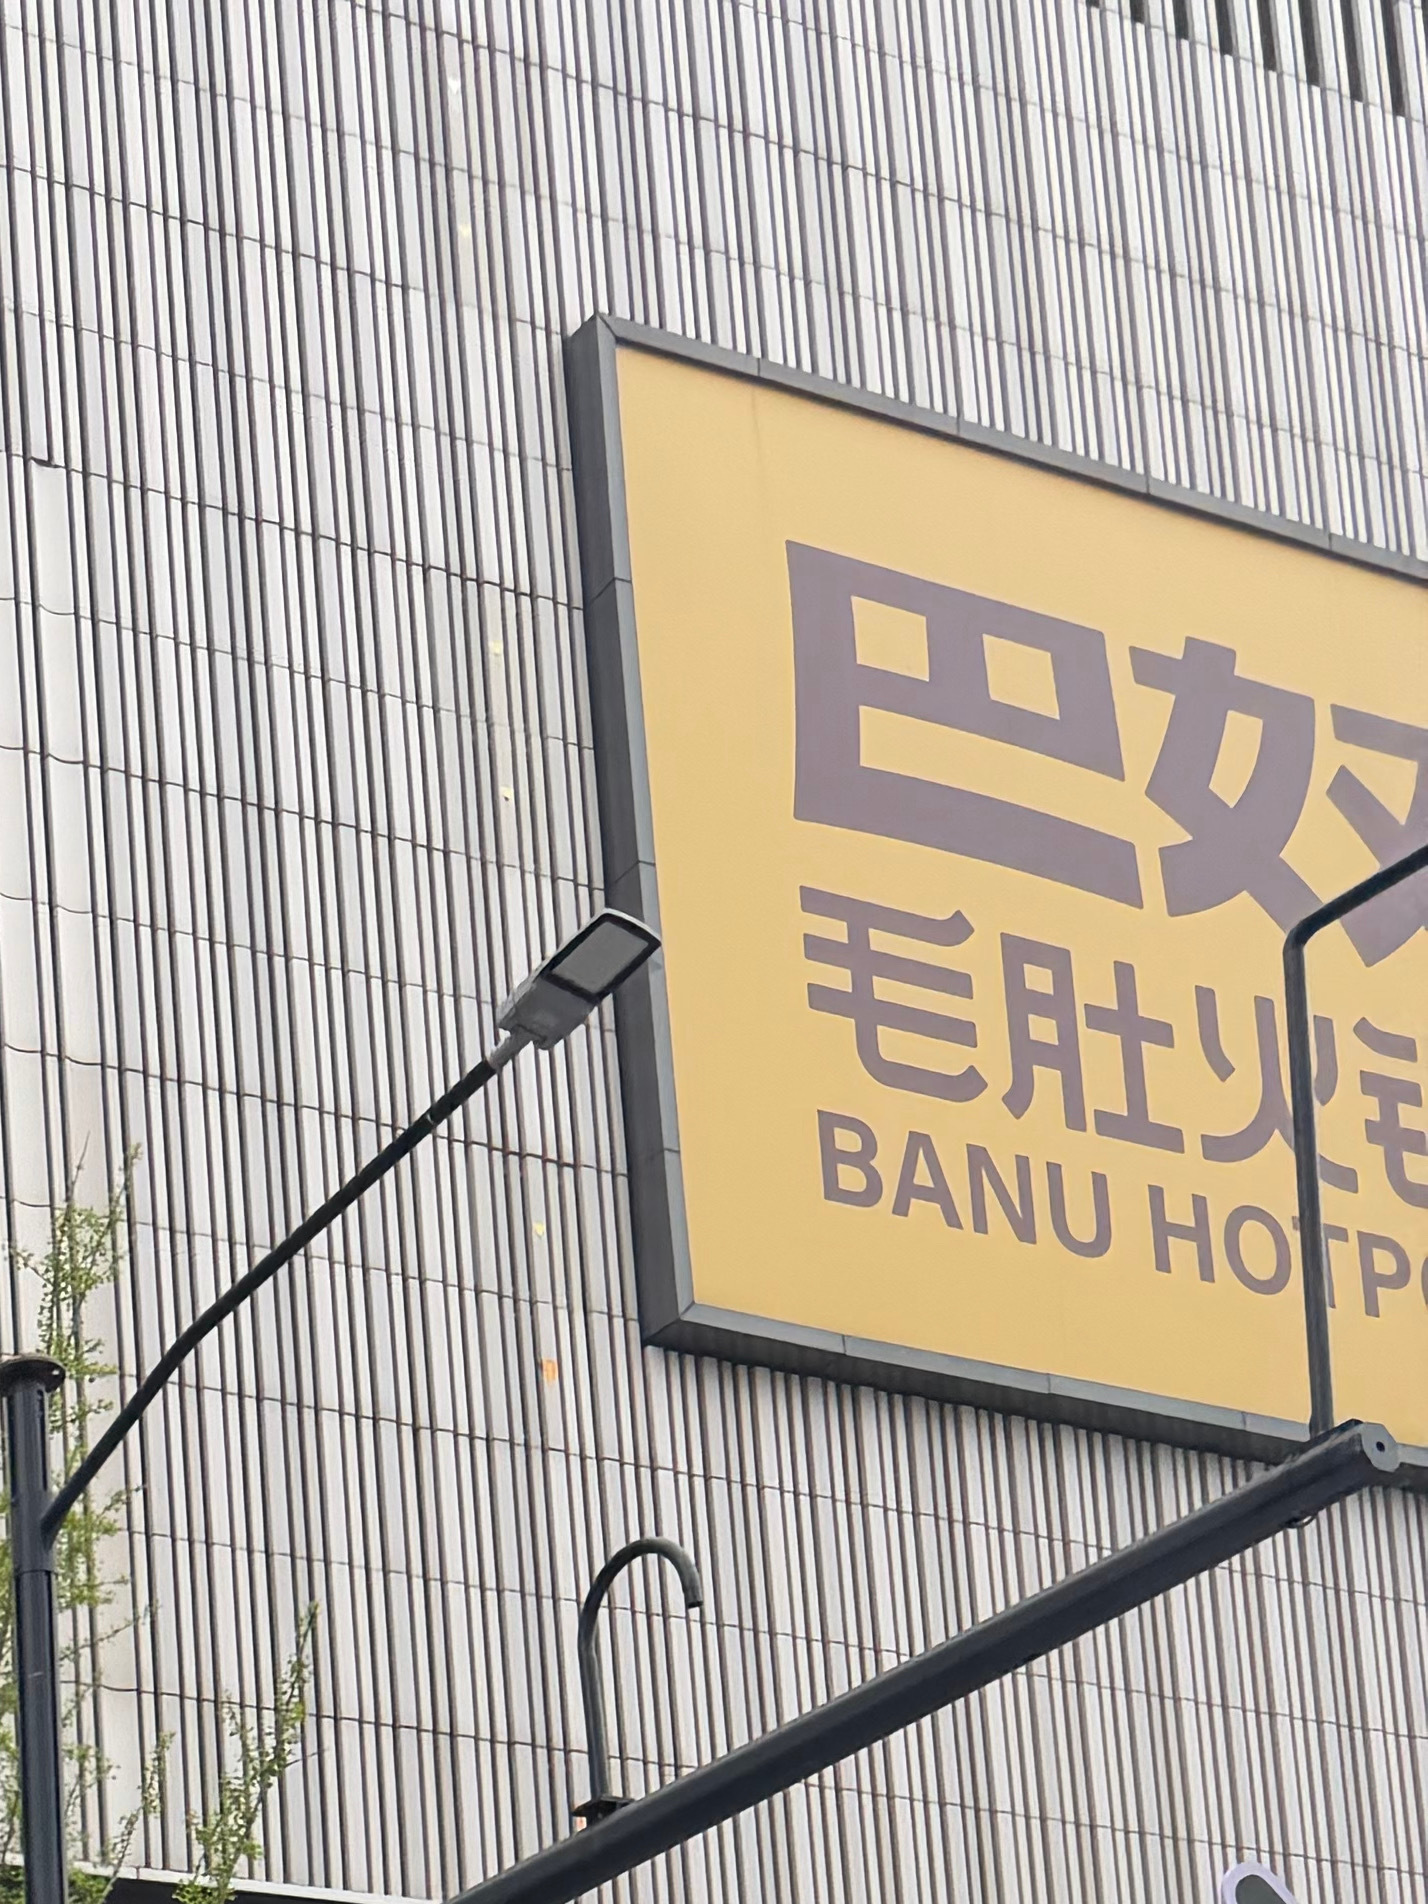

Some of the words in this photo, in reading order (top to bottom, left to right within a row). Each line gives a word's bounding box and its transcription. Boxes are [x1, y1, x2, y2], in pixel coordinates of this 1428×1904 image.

[785, 540, 1428, 966] 巴奴
[816, 1108, 1113, 1260] BANU
[1146, 1184, 1428, 1319] HOTP
